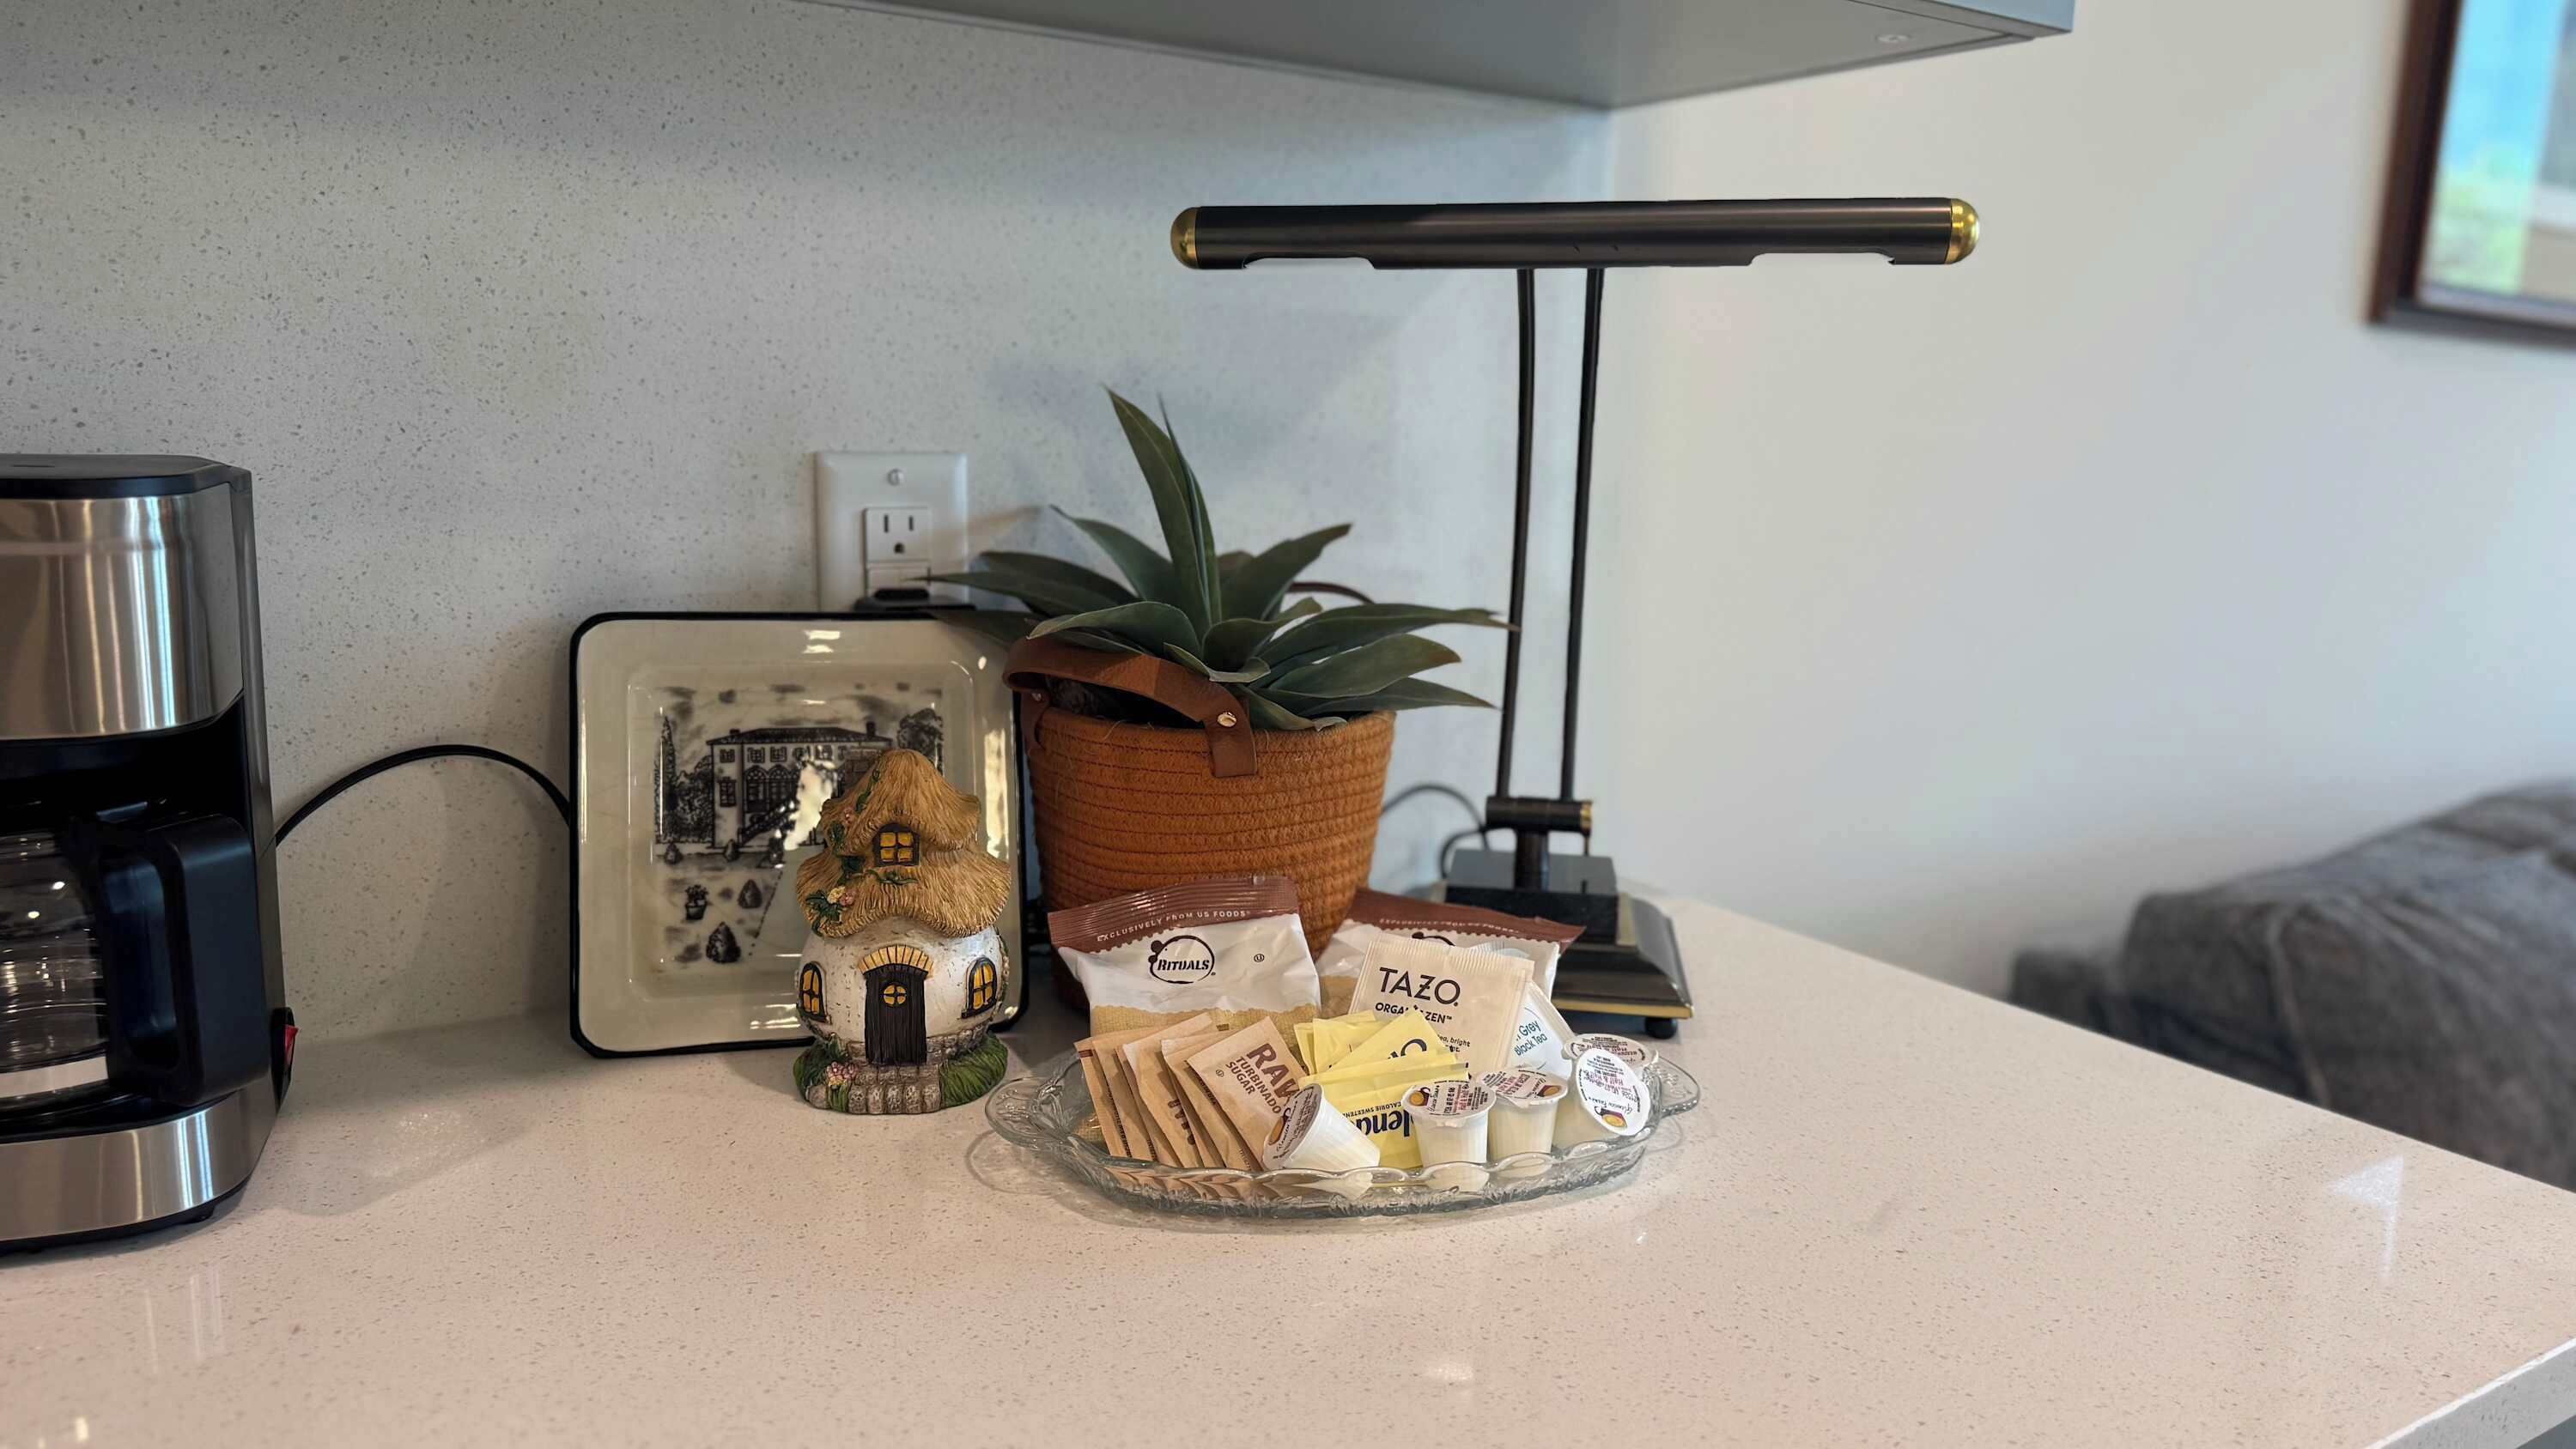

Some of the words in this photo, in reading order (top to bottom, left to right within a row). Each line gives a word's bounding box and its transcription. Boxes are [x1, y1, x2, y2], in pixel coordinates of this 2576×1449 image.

[1097, 918, 1163, 943] EXCLUSIVELY
[1166, 912, 1193, 923] FROM
[1213, 910, 1246, 919] FOODS
[1379, 967, 1461, 1006] TAZO
[1375, 1002, 1424, 1015] ORGA
[1518, 1020, 1541, 1037] Grey
[1449, 1037, 1471, 1047] bright
[1514, 1040, 1536, 1057] Black
[1532, 1033, 1548, 1045] Tea
[1225, 1061, 1256, 1095] SUGAR
[1236, 1056, 1282, 1114] TURBINADO
[1342, 1106, 1375, 1119] SWEETEN
